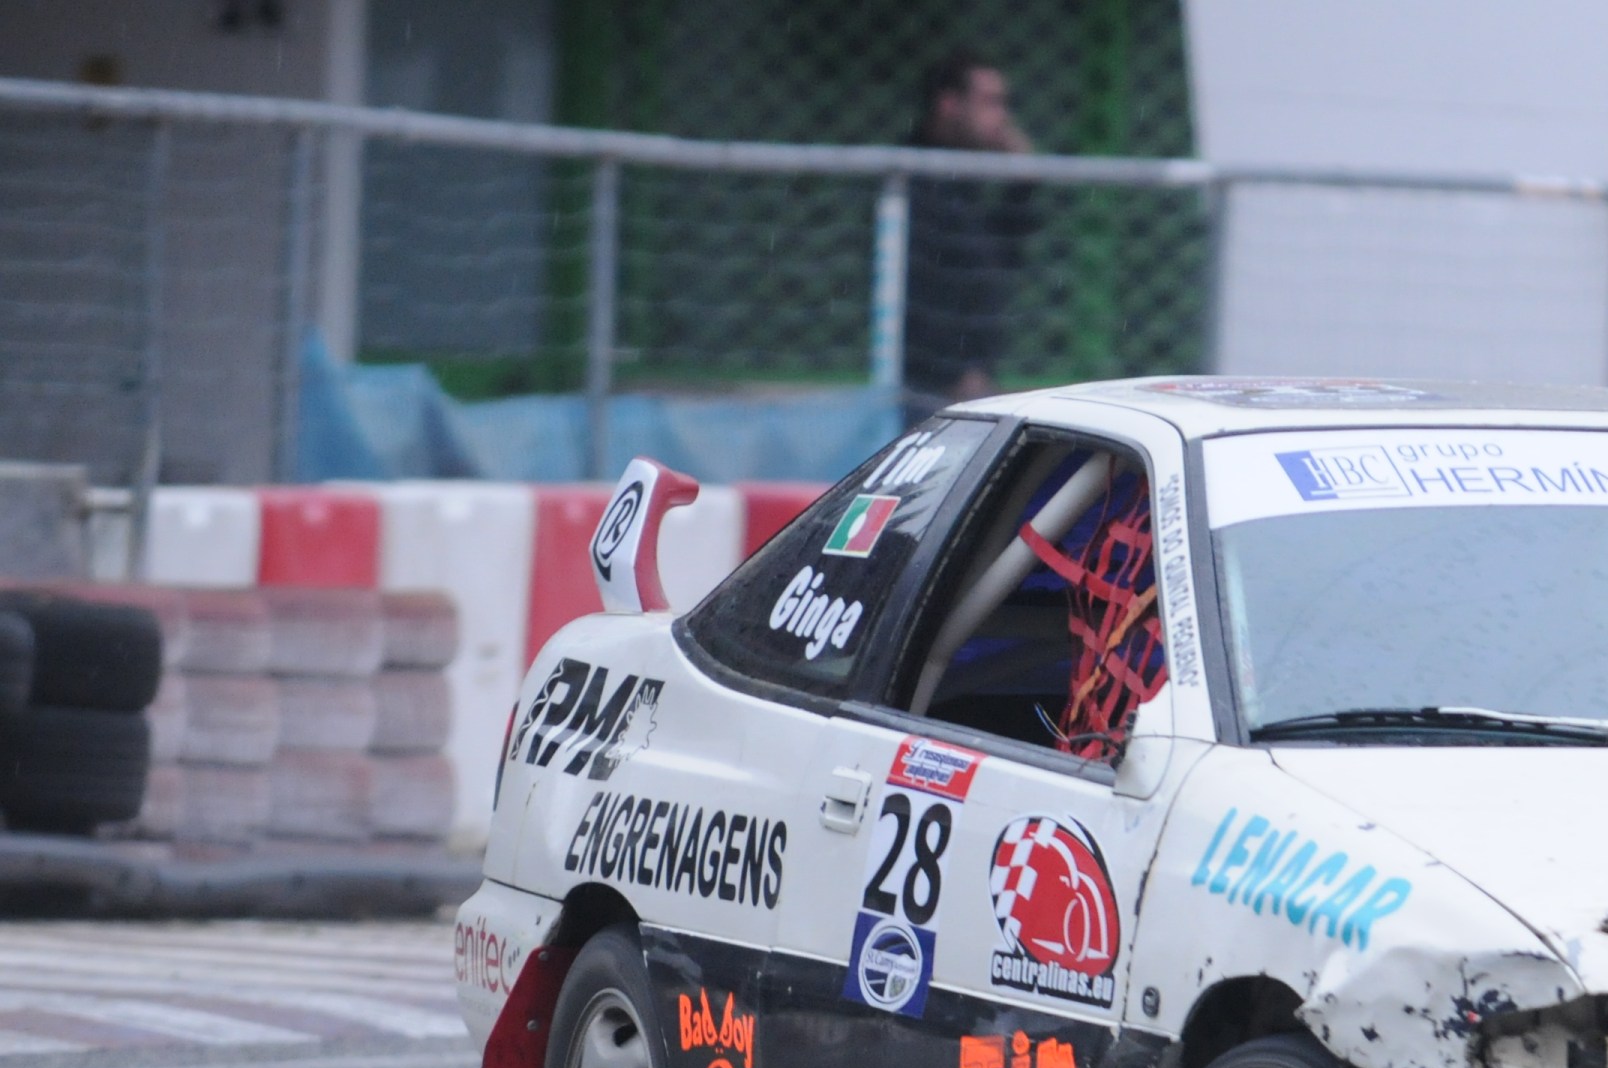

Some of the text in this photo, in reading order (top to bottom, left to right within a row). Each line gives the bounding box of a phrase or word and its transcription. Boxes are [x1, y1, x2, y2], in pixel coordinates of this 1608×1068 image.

[1397, 443, 1503, 462] grupo
[769, 565, 863, 660] Ginga
[564, 791, 788, 910] ENGRENAGENS
[862, 793, 952, 925] 28
[1190, 806, 1413, 952] LENACAR
[991, 953, 1115, 1002] centralinas.eu
